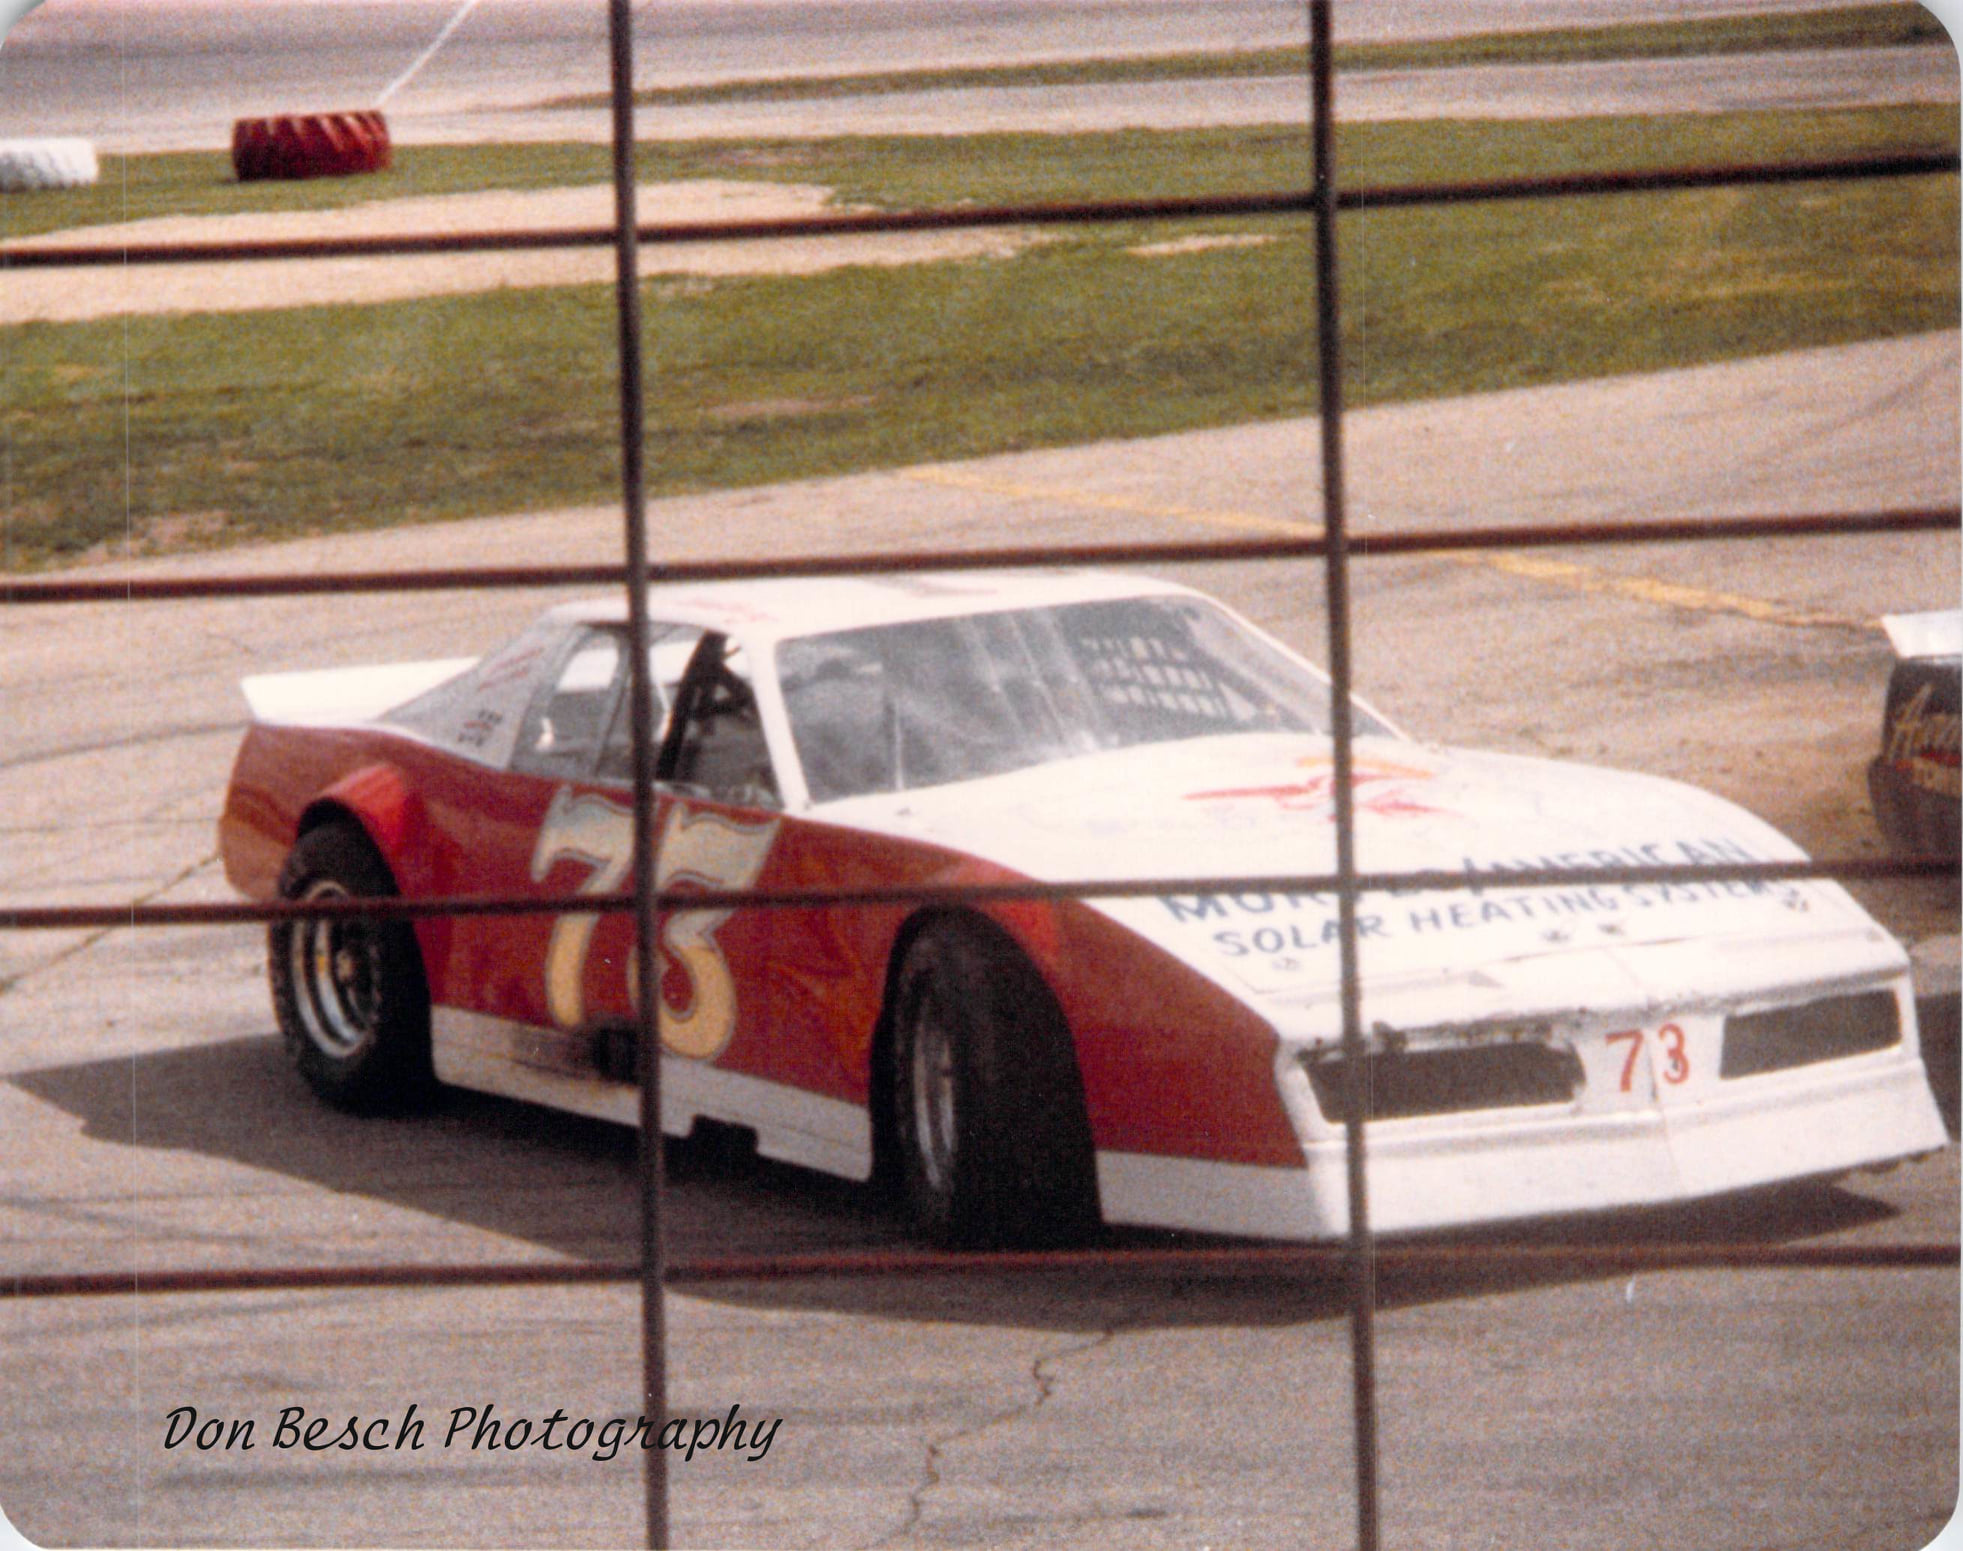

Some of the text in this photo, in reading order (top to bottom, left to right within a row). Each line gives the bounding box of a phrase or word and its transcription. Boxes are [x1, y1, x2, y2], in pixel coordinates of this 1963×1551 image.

[530, 784, 782, 1061] 73
[1212, 914, 1393, 957] SOLAR
[1407, 884, 1619, 932] HEATING
[1604, 1022, 1690, 1093] 73
